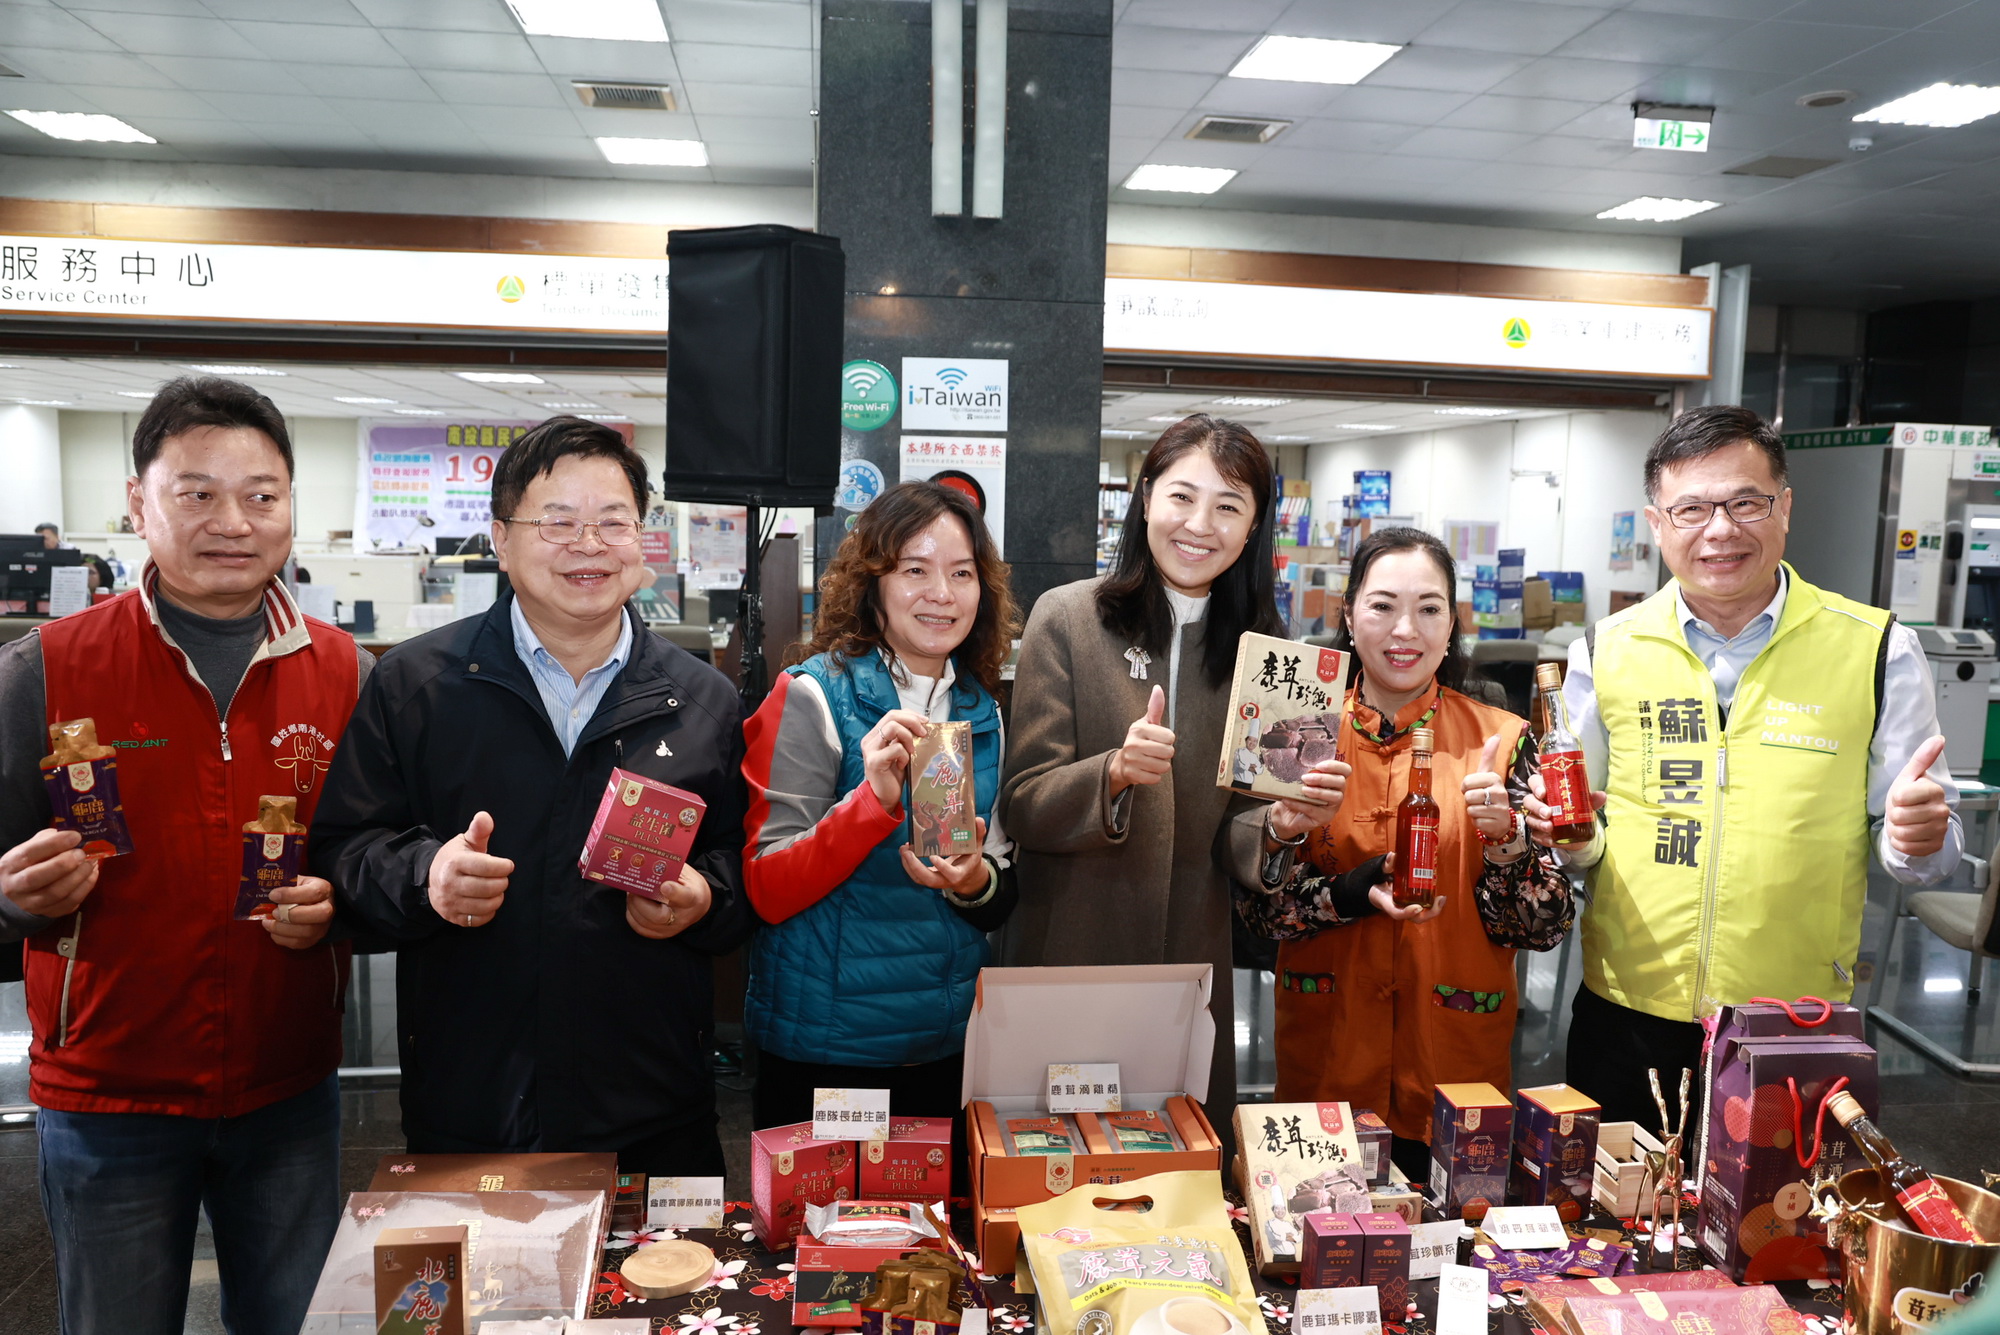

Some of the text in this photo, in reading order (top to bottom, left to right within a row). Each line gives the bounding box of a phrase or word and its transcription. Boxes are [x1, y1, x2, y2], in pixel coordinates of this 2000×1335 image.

[2, 246, 214, 286] 服務中心
[1, 285, 149, 305] Service Center
[984, 384, 1002, 392] WiFi
[843, 402, 890, 412] Free Wi-Fi
[1846, 431, 1871, 444] ATM
[1922, 429, 1991, 447] 中華郵政
[1638, 700, 1653, 730] 議員
[1765, 699, 1824, 715] LIGHT
[1764, 714, 1790, 726] UP
[1760, 730, 1840, 751] NANTOU
[1646, 732, 1654, 775] NANTOU
[1654, 698, 1708, 868] 蘇昱誠
[630, 811, 677, 839] 益生菌
[634, 829, 661, 845] PLUS
[814, 1110, 887, 1123] 鹿隊長益生菌
[883, 1167, 928, 1182] 益生菌
[793, 1174, 836, 1198] 益生菌
[892, 1182, 918, 1191] PLUS
[801, 1192, 827, 1205] PLUS
[1083, 1290, 1099, 1302] Oats
[1099, 1286, 1105, 1294] &
[1301, 1310, 1378, 1329] 鹿茸瑪卡膠囊
